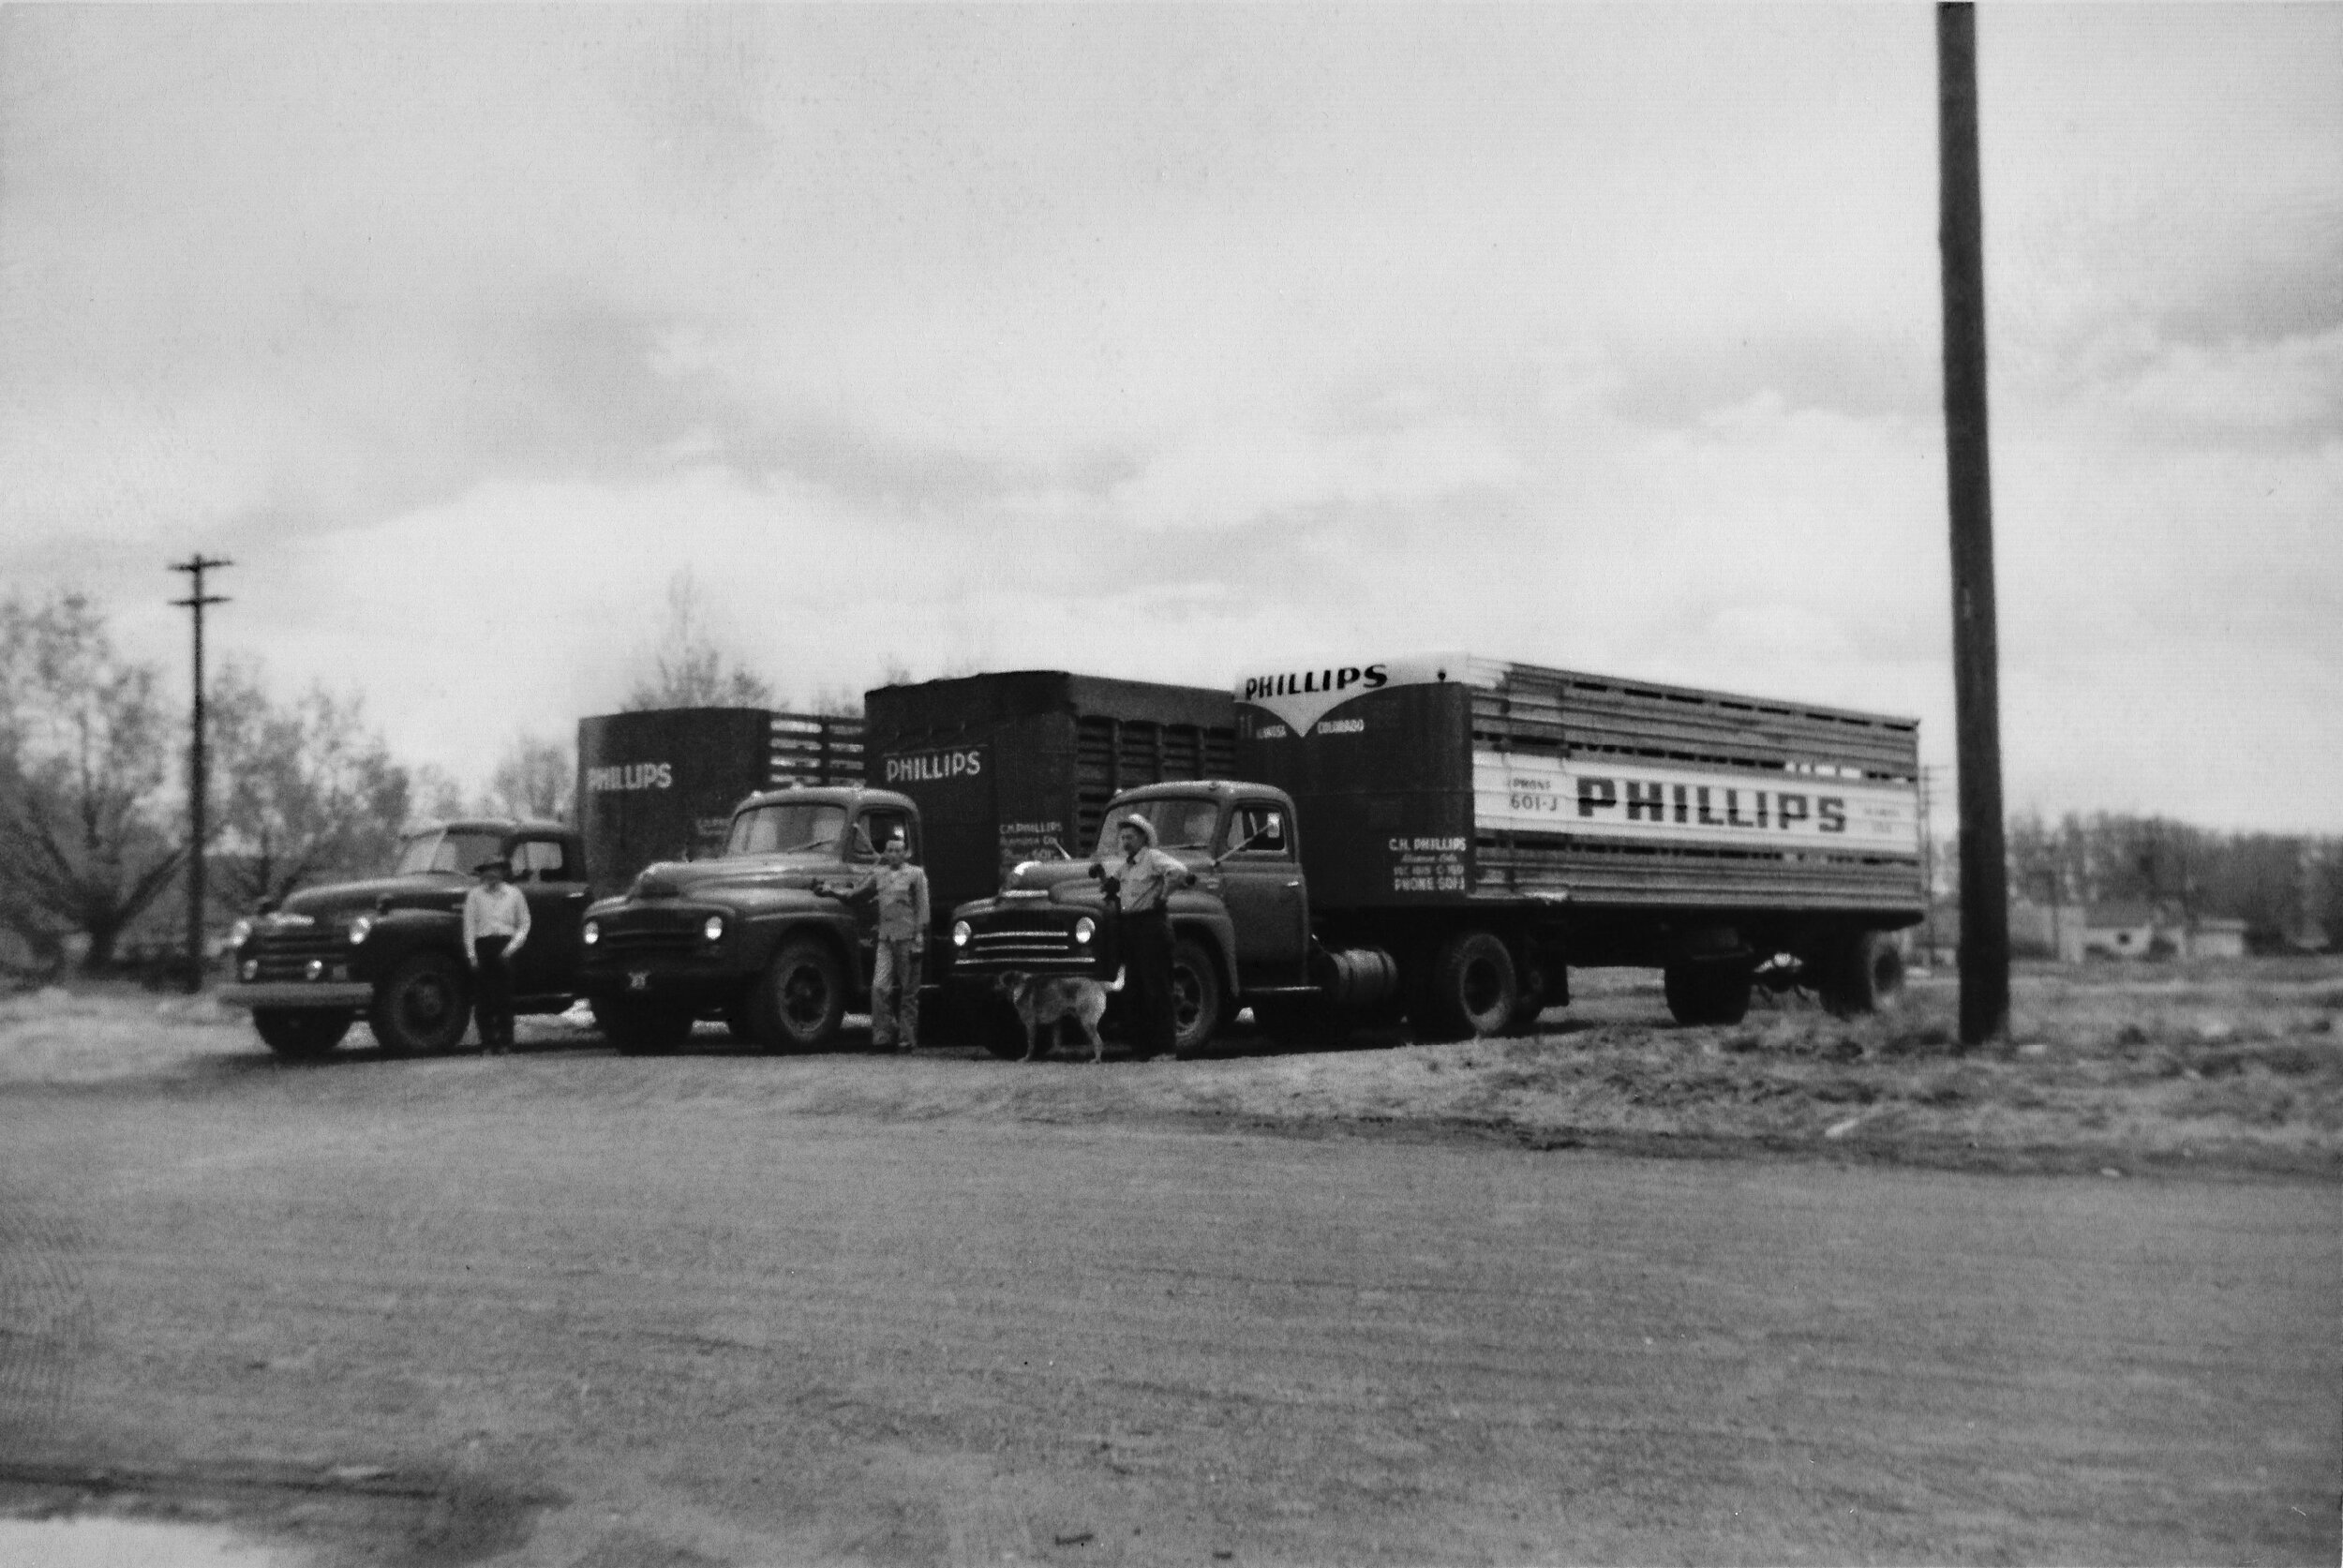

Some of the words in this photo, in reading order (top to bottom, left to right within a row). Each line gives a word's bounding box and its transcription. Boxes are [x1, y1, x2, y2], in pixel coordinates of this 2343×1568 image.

[1246, 664, 1388, 701] PHILLIPS
[587, 762, 673, 791] PHILLIPS
[886, 750, 981, 783] PHILLIPS
[1511, 794, 1558, 812] 601-J
[1576, 777, 1845, 833] PHILLIPS
[1413, 837, 1467, 851] PHILLIPS
